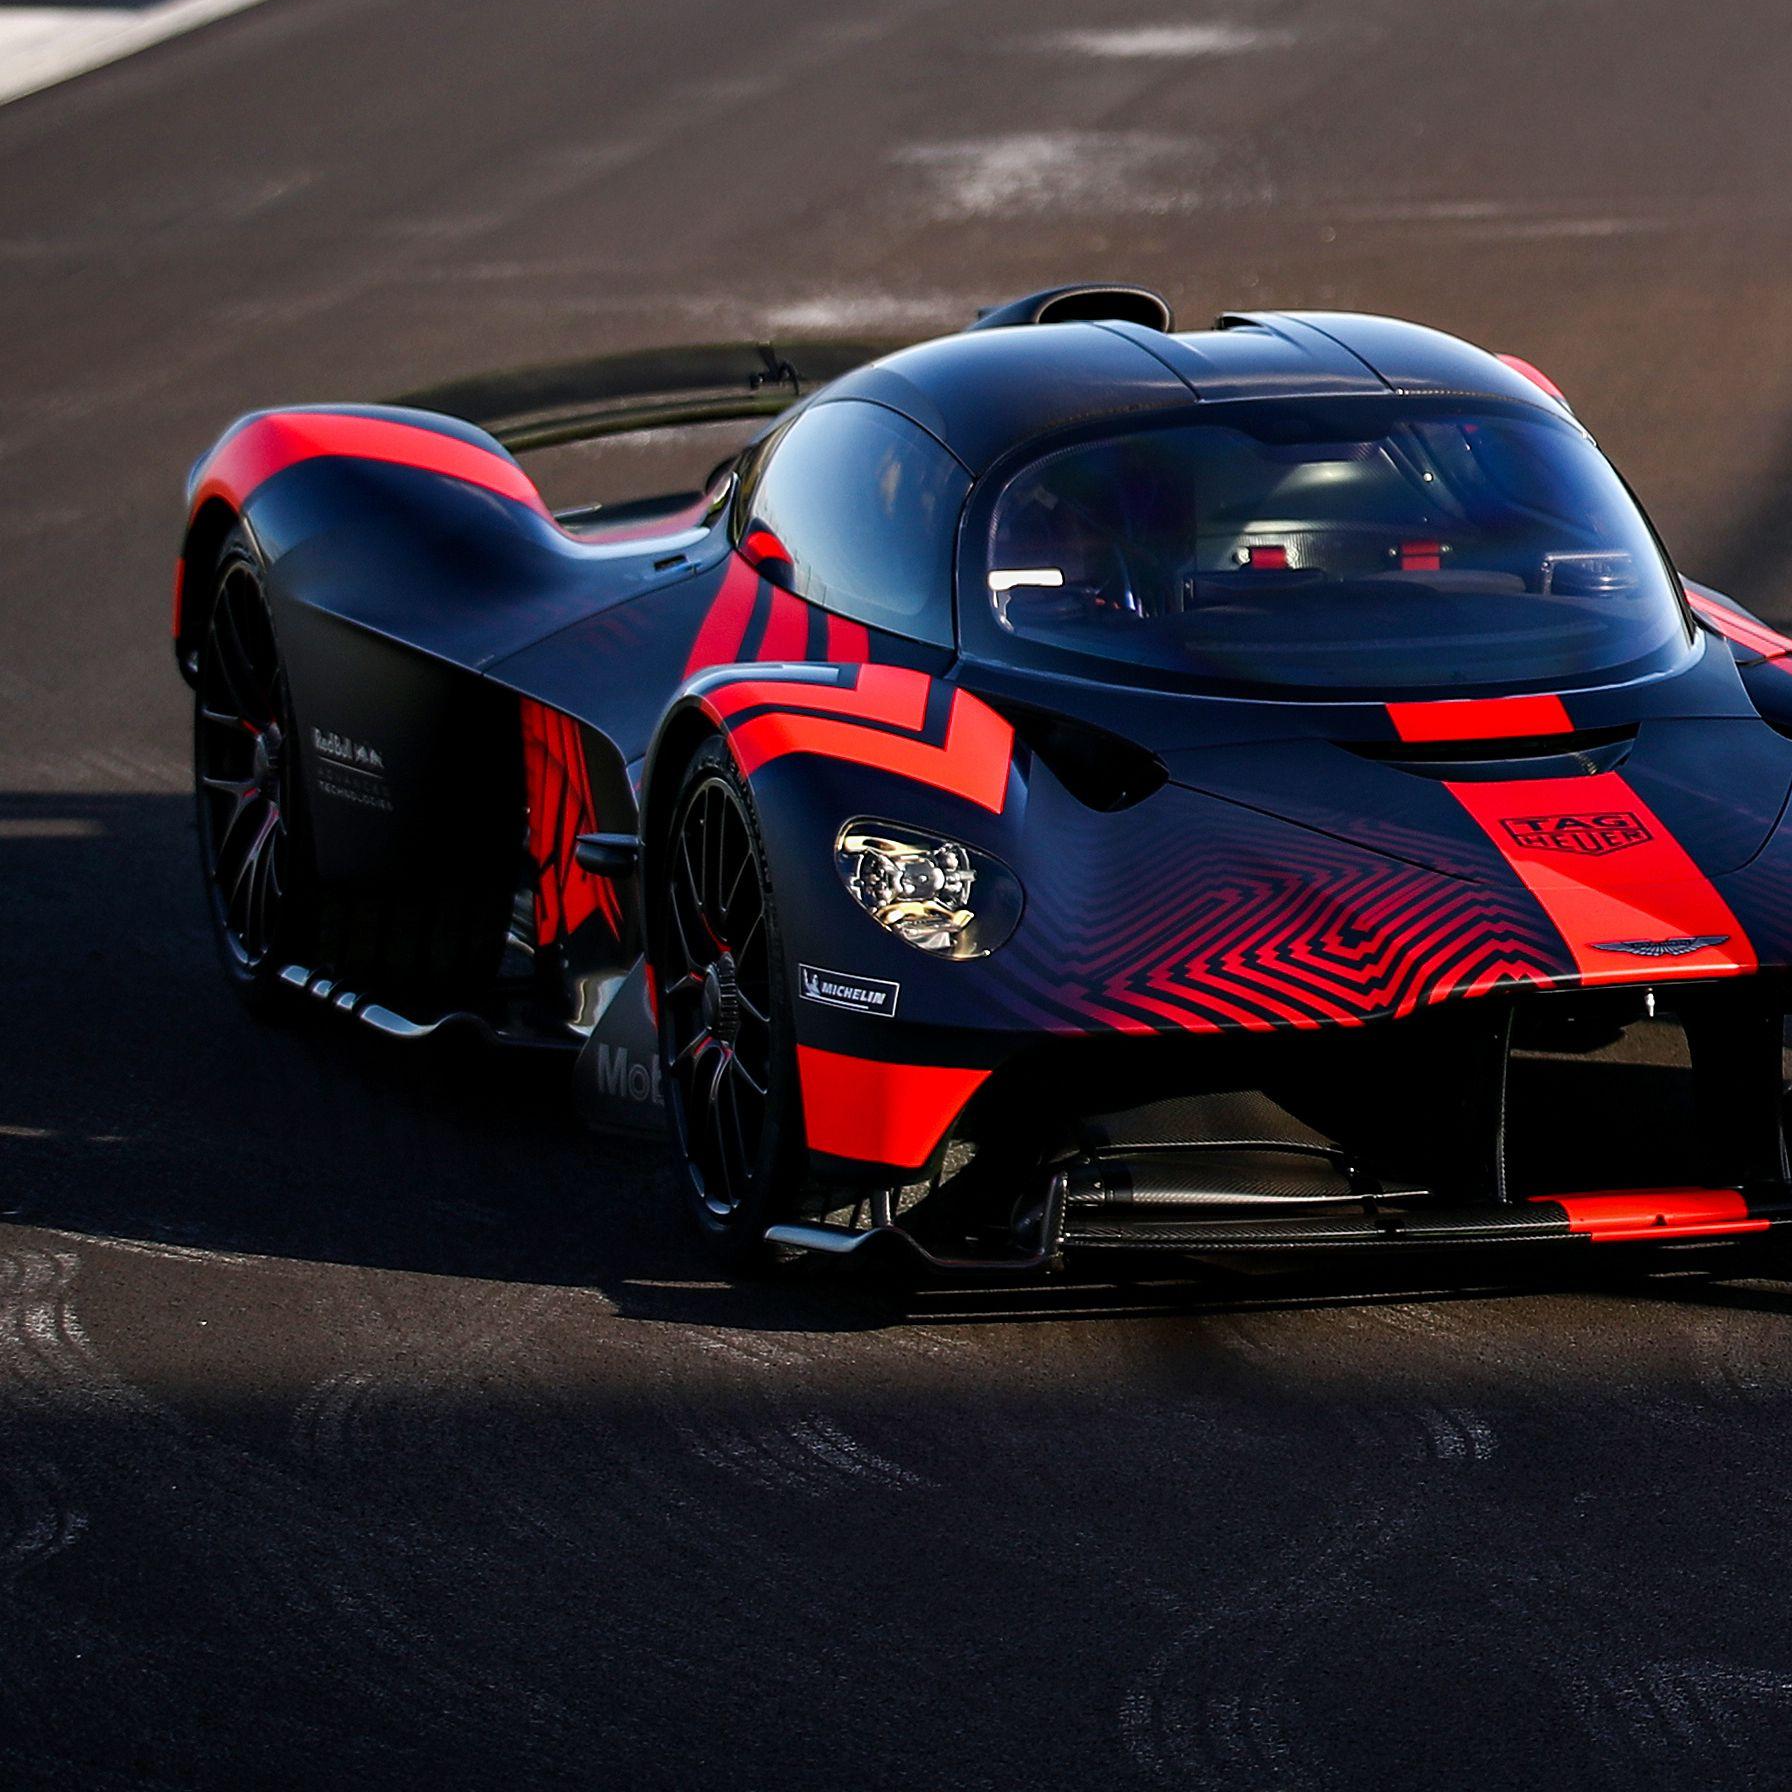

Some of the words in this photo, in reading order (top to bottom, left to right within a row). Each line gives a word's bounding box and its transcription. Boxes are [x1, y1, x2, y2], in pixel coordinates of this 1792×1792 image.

[1516, 814, 1630, 833] TAG
[1519, 828, 1645, 853] HEUER
[820, 982, 887, 1006] MICHELIN
